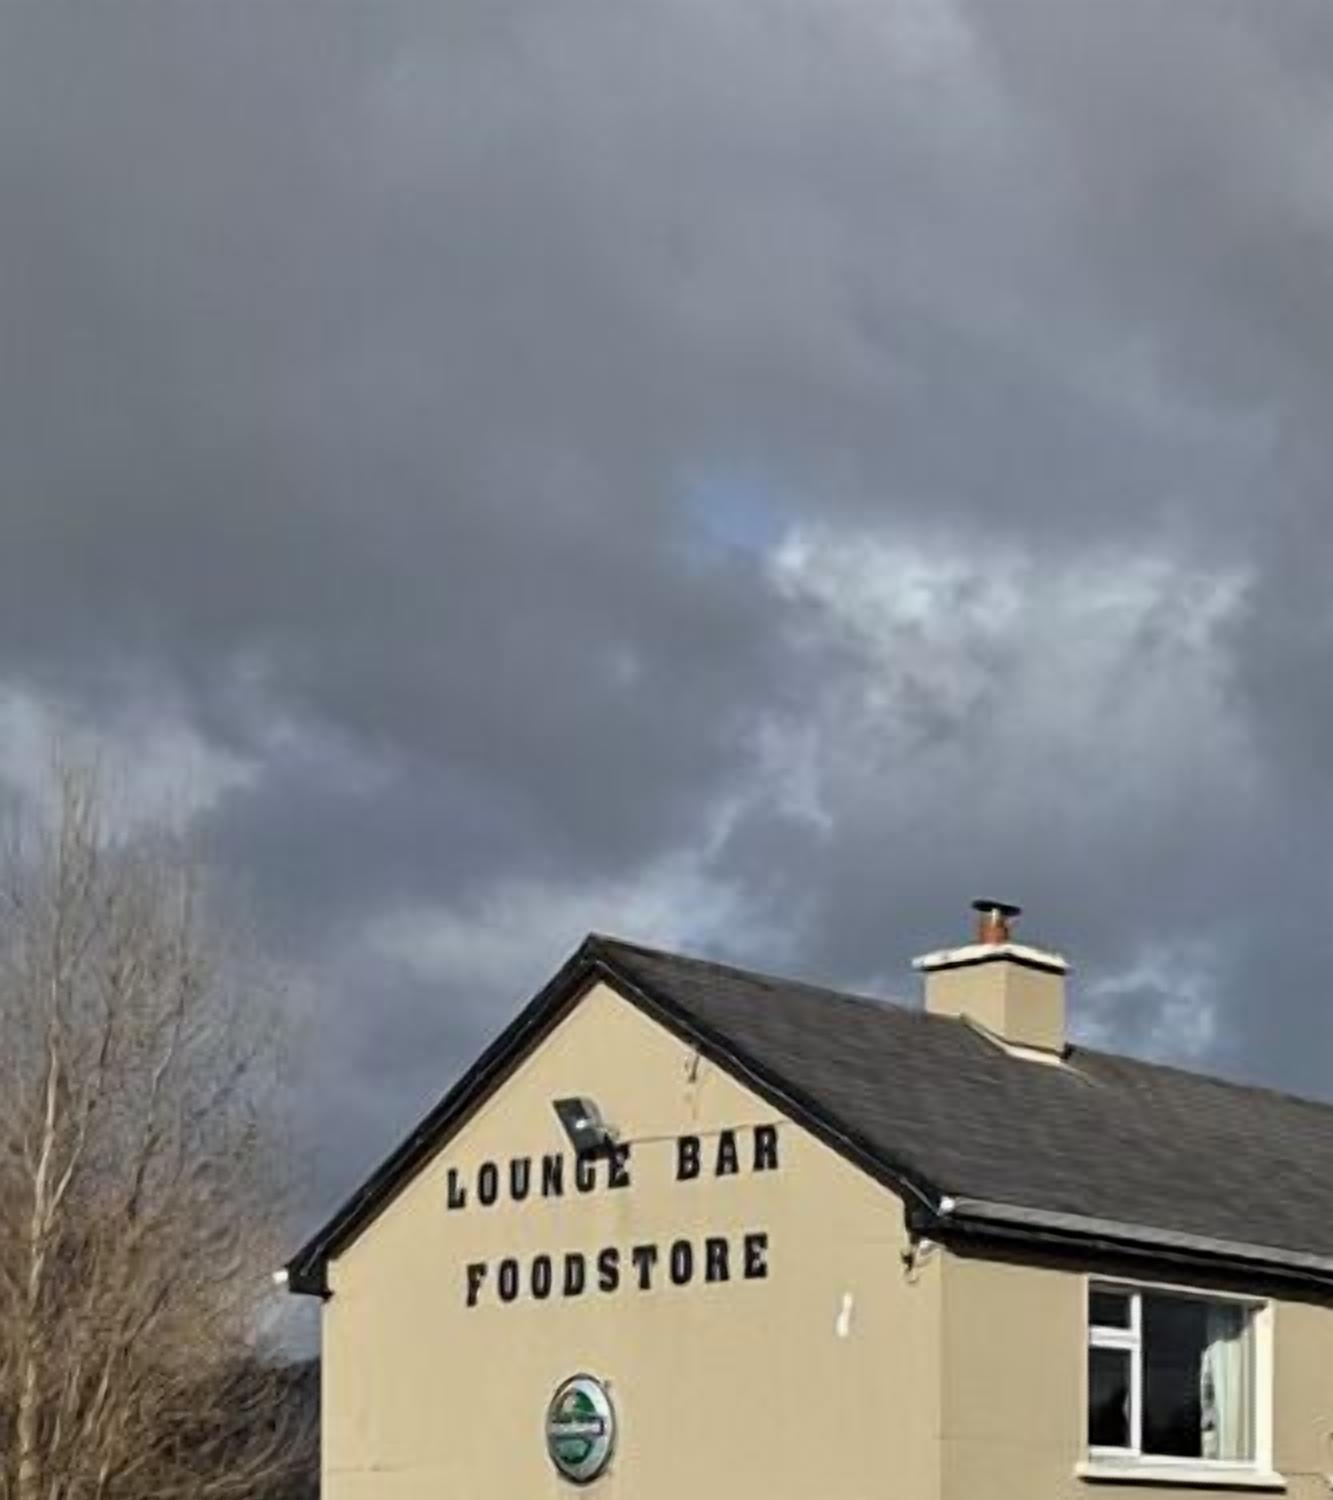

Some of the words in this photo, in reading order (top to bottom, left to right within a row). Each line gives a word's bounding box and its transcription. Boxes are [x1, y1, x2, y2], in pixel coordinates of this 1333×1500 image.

[447, 1144, 630, 1209] LOUNGE
[677, 1125, 778, 1181] BAR
[466, 1233, 768, 1306] FOODSTORE
